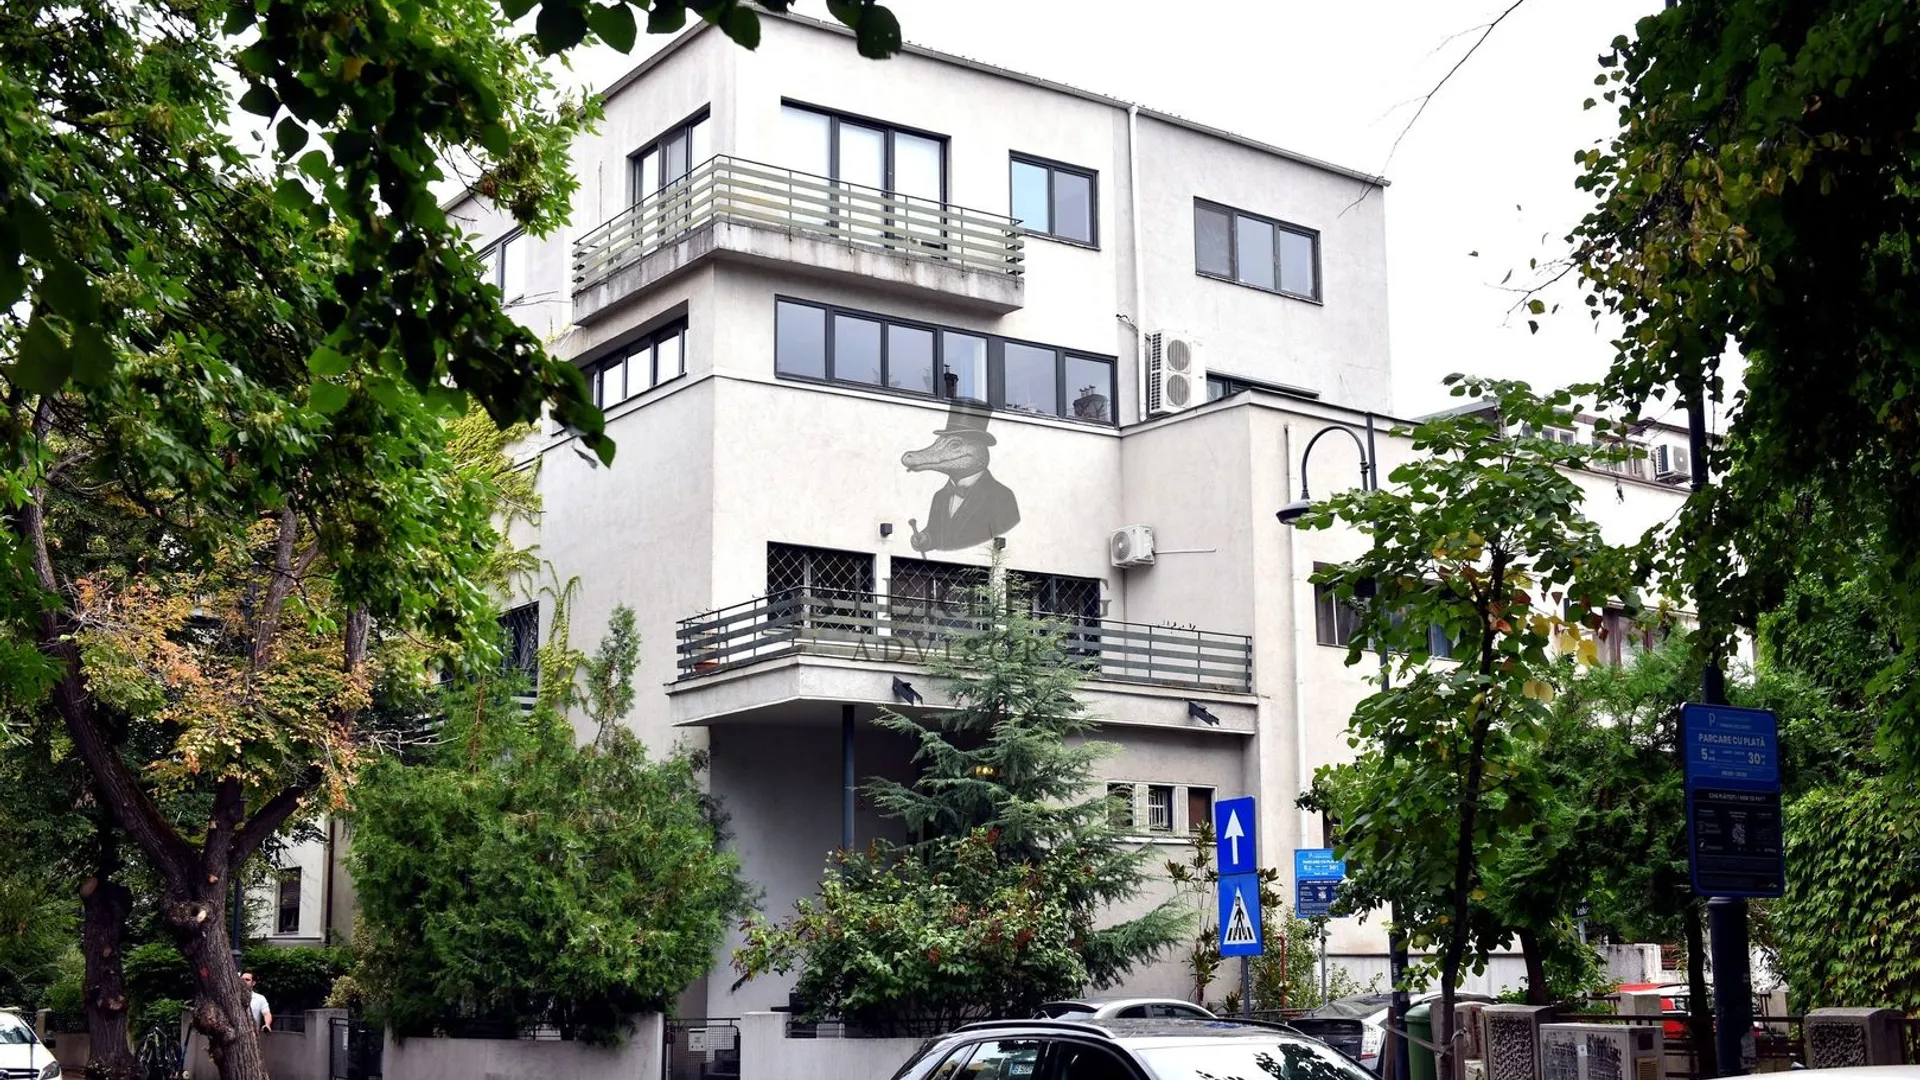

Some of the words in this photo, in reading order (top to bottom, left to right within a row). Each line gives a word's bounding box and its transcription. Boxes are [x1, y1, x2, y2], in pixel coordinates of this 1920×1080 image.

[1698, 732, 1732, 744] PARCARE
[1732, 735, 1743, 745] CU
[1743, 736, 1766, 747] PLATĂ
[1700, 747, 1708, 760] 5
[1748, 751, 1761, 764] 30
